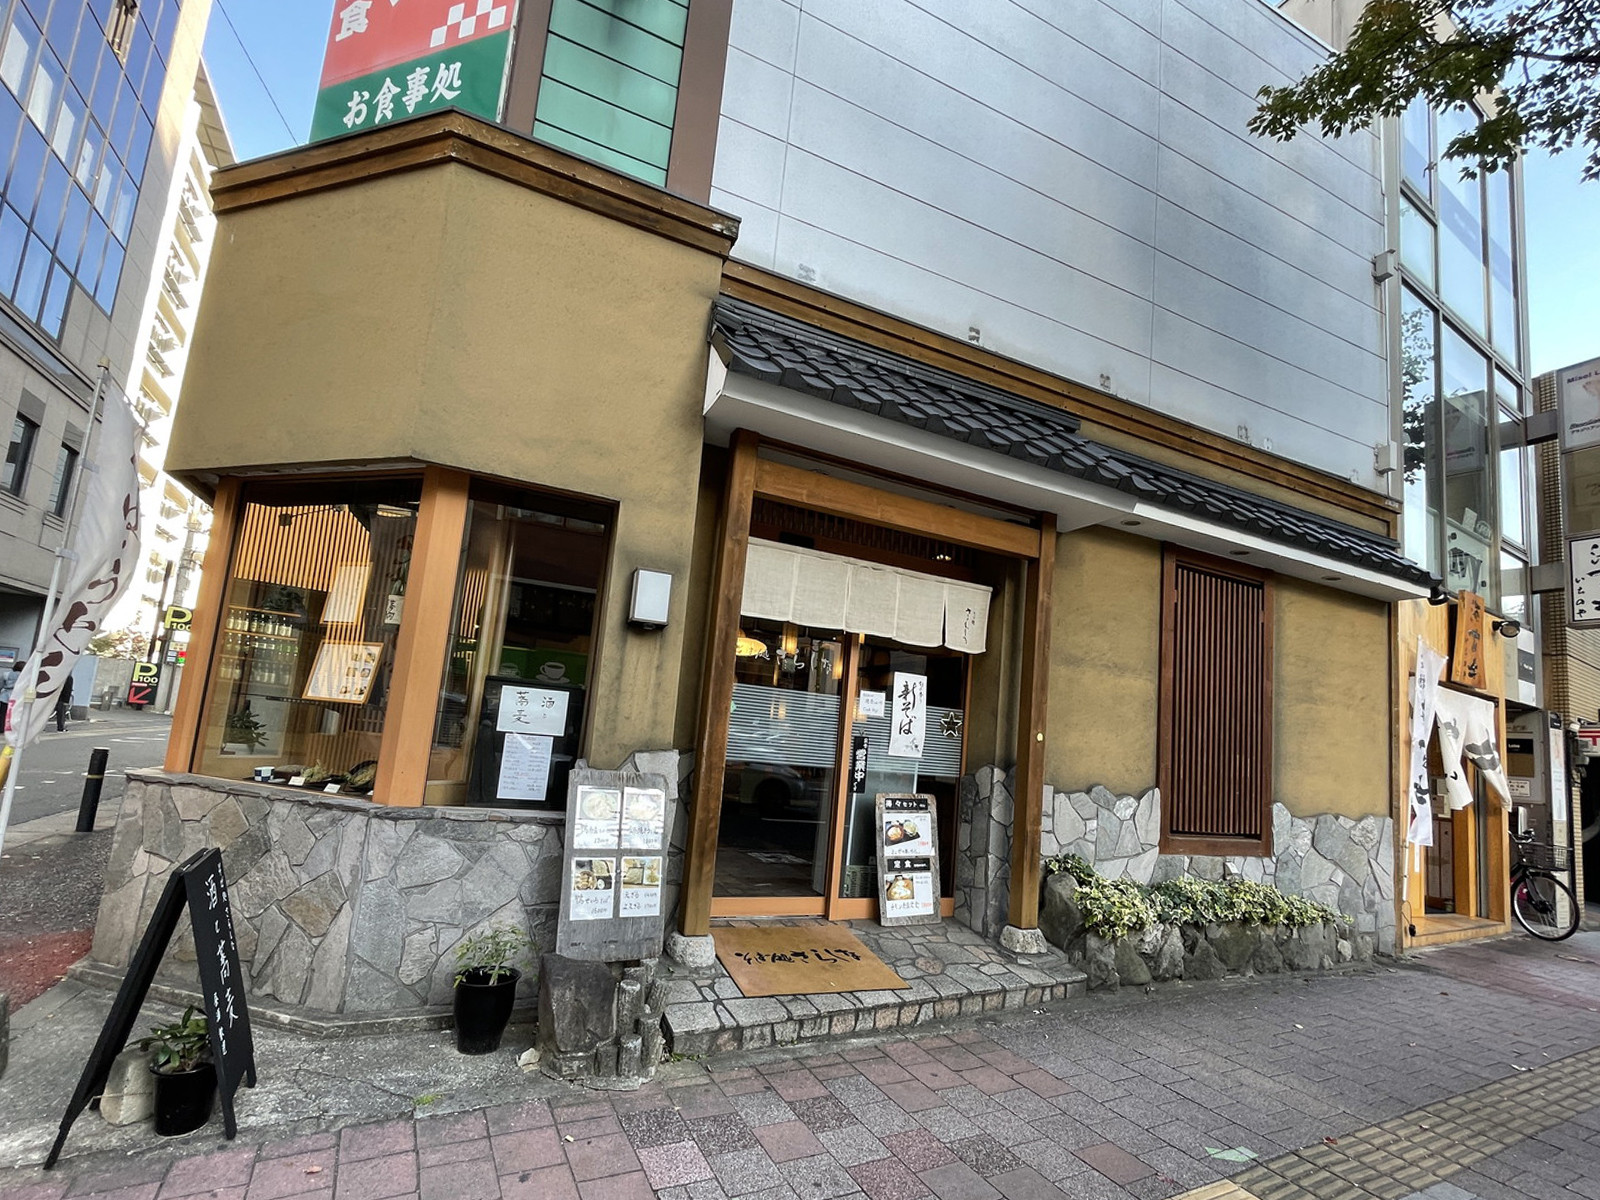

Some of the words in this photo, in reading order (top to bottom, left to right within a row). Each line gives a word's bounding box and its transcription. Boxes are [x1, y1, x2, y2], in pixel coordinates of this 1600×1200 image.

[343, 61, 462, 129] お食事処
[164, 605, 193, 629] P
[132, 662, 159, 682] P
[138, 676, 159, 684] 100
[897, 680, 917, 735] 新そば
